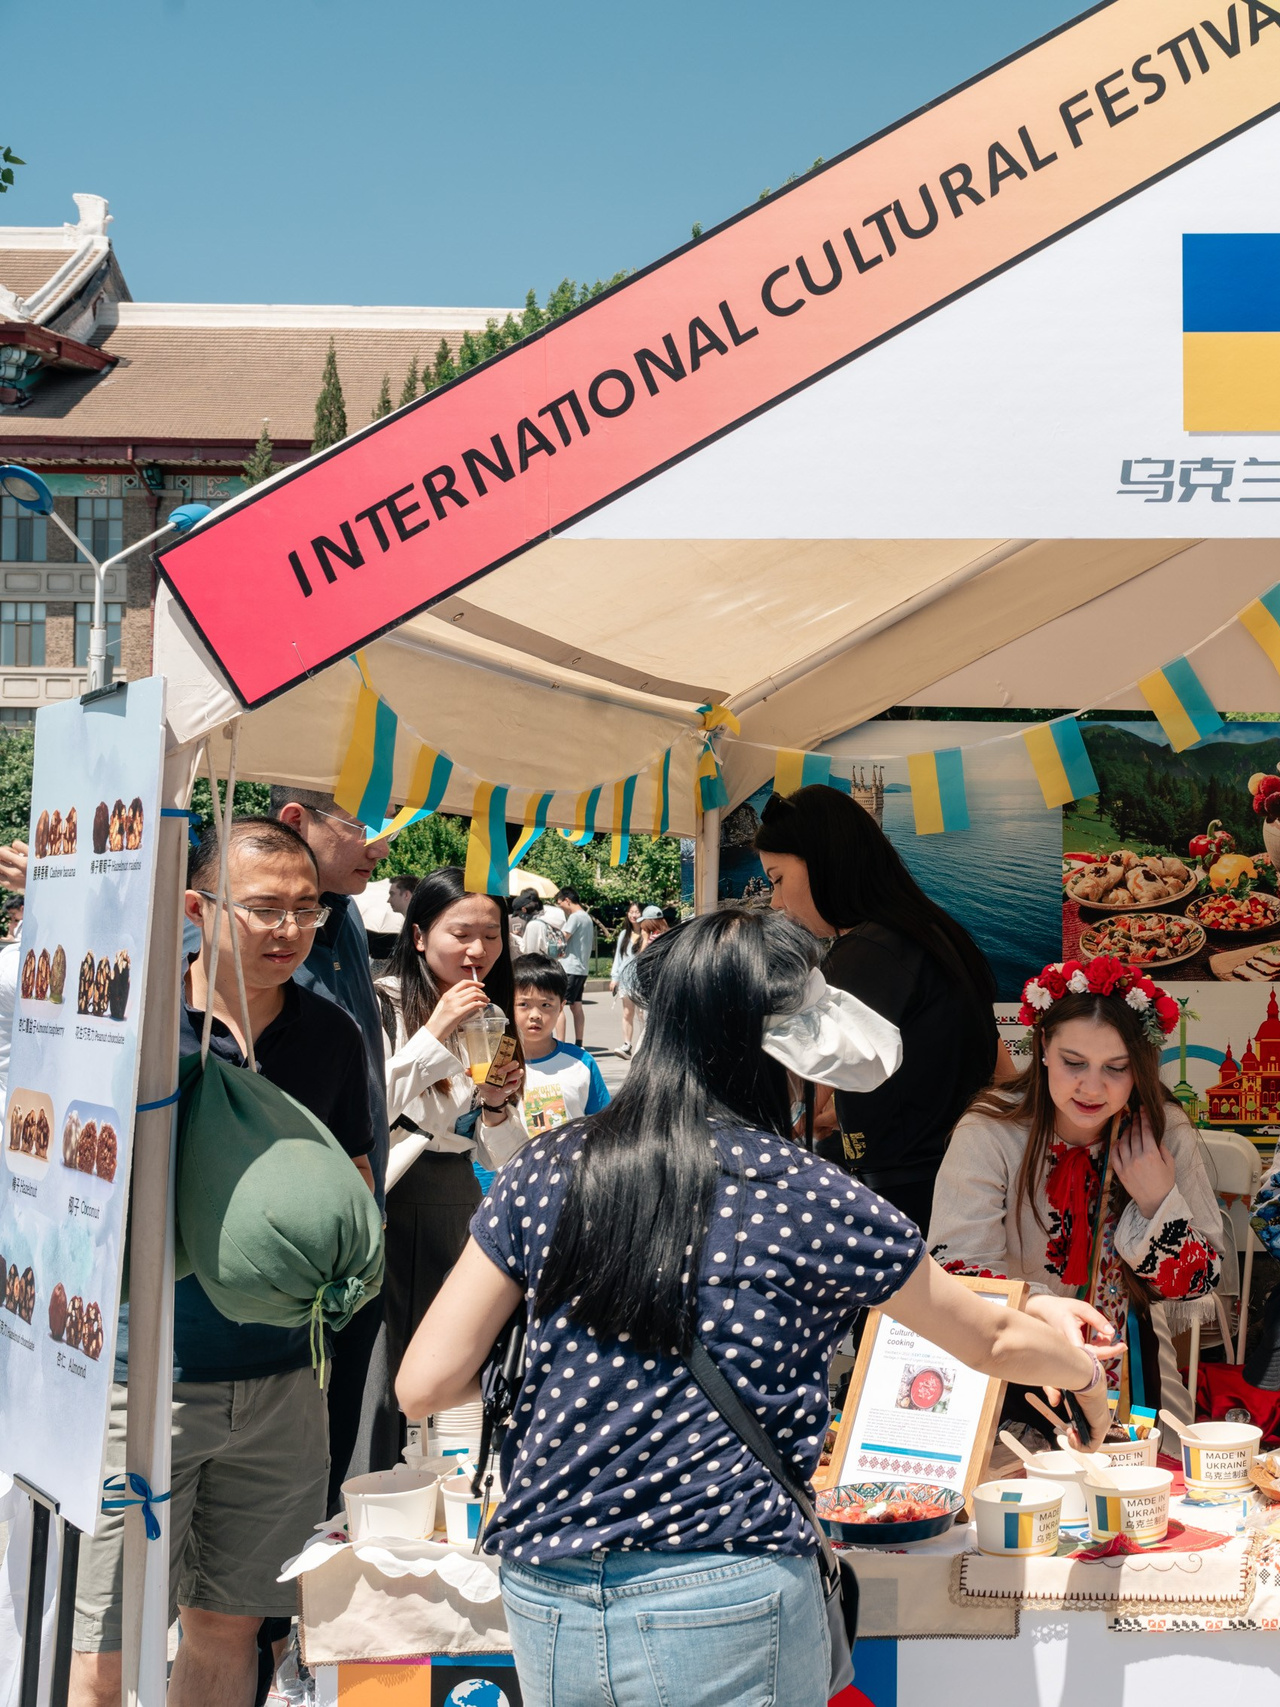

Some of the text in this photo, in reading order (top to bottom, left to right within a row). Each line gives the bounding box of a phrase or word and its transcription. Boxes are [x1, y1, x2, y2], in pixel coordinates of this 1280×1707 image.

[288, 300, 758, 597] INTERNATIONAL
[761, 125, 1058, 317] CULTURAL
[81, 1200, 100, 1219] Coconut
[890, 1327, 915, 1338] Culture
[887, 1338, 915, 1349] cooking
[68, 1358, 87, 1378] Almond
[1108, 1453, 1131, 1461] ADE
[1206, 1452, 1234, 1460] MADE
[1206, 1460, 1247, 1469] UKRAINE
[1205, 1469, 1248, 1480] 乌克兰制造
[1127, 1494, 1166, 1507] MADE IN
[1127, 1504, 1166, 1518] UKRAINE
